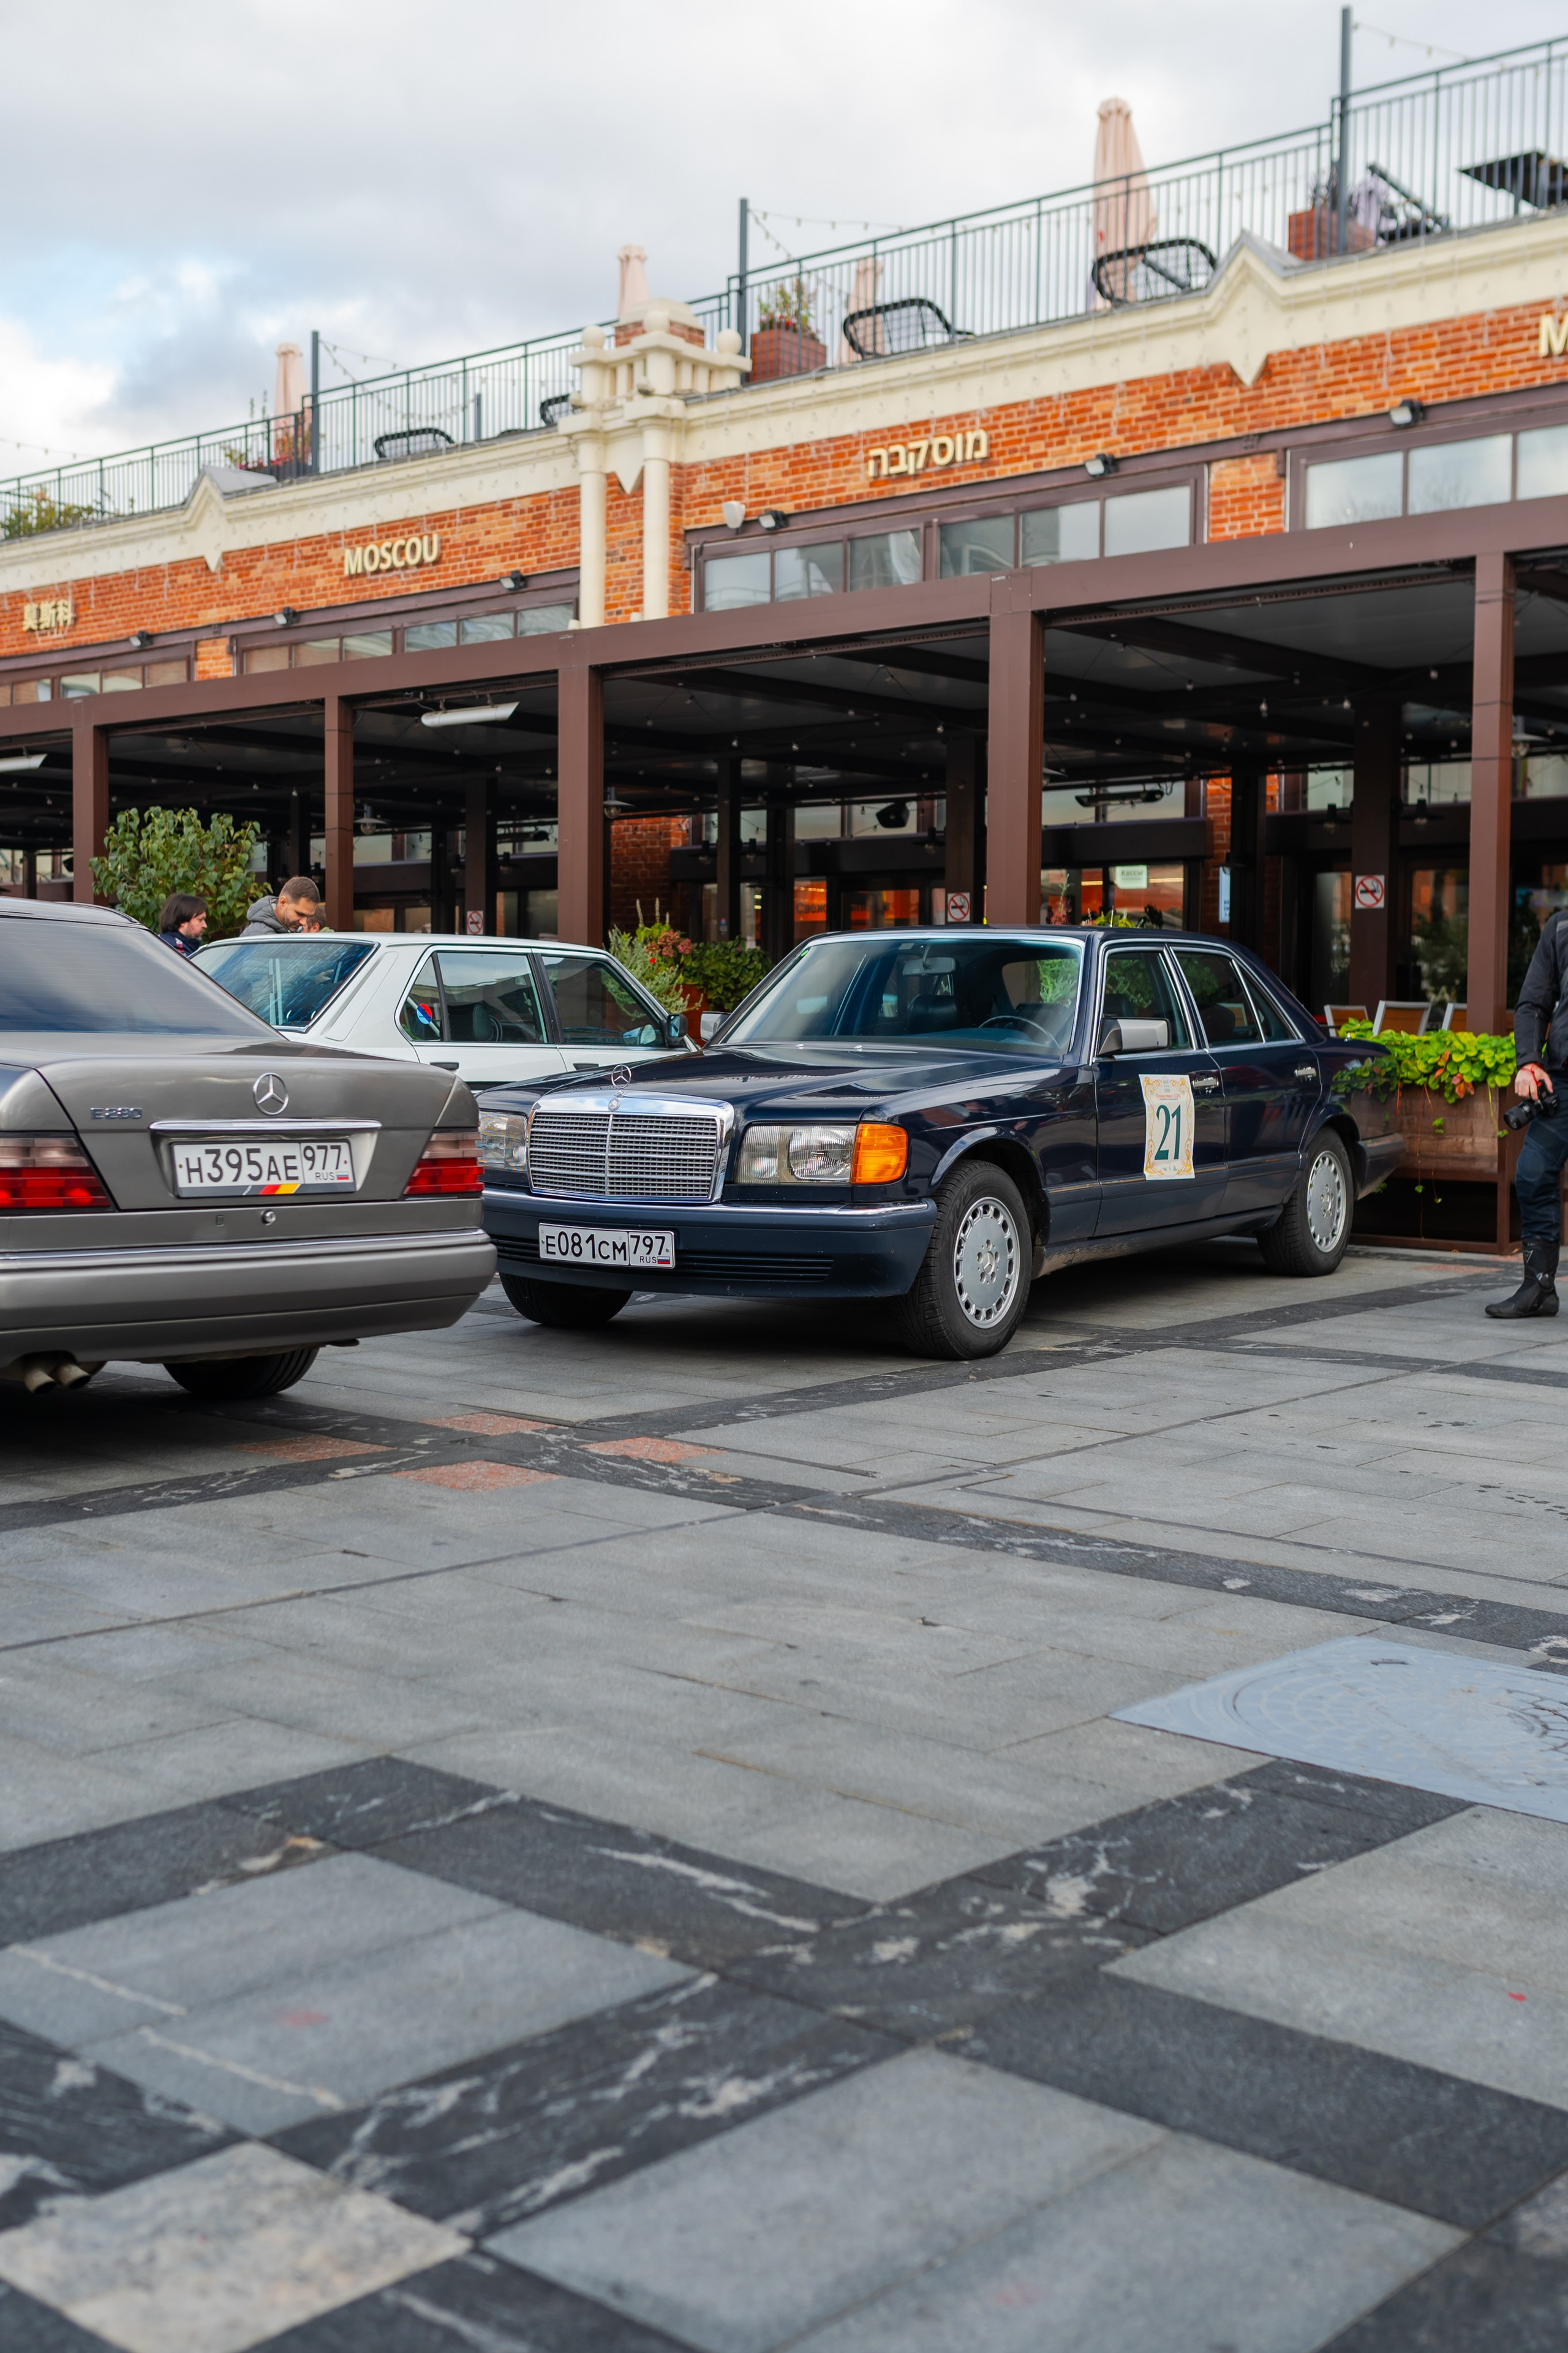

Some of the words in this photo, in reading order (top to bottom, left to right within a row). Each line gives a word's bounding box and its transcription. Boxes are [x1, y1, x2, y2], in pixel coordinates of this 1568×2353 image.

[867, 428, 988, 477] מוסקבה
[344, 533, 439, 576] MOSCOU
[1154, 1104, 1181, 1160] 21
[303, 1145, 342, 1171] 977
[315, 1172, 335, 1180] RUS
[630, 1234, 666, 1256] 797
